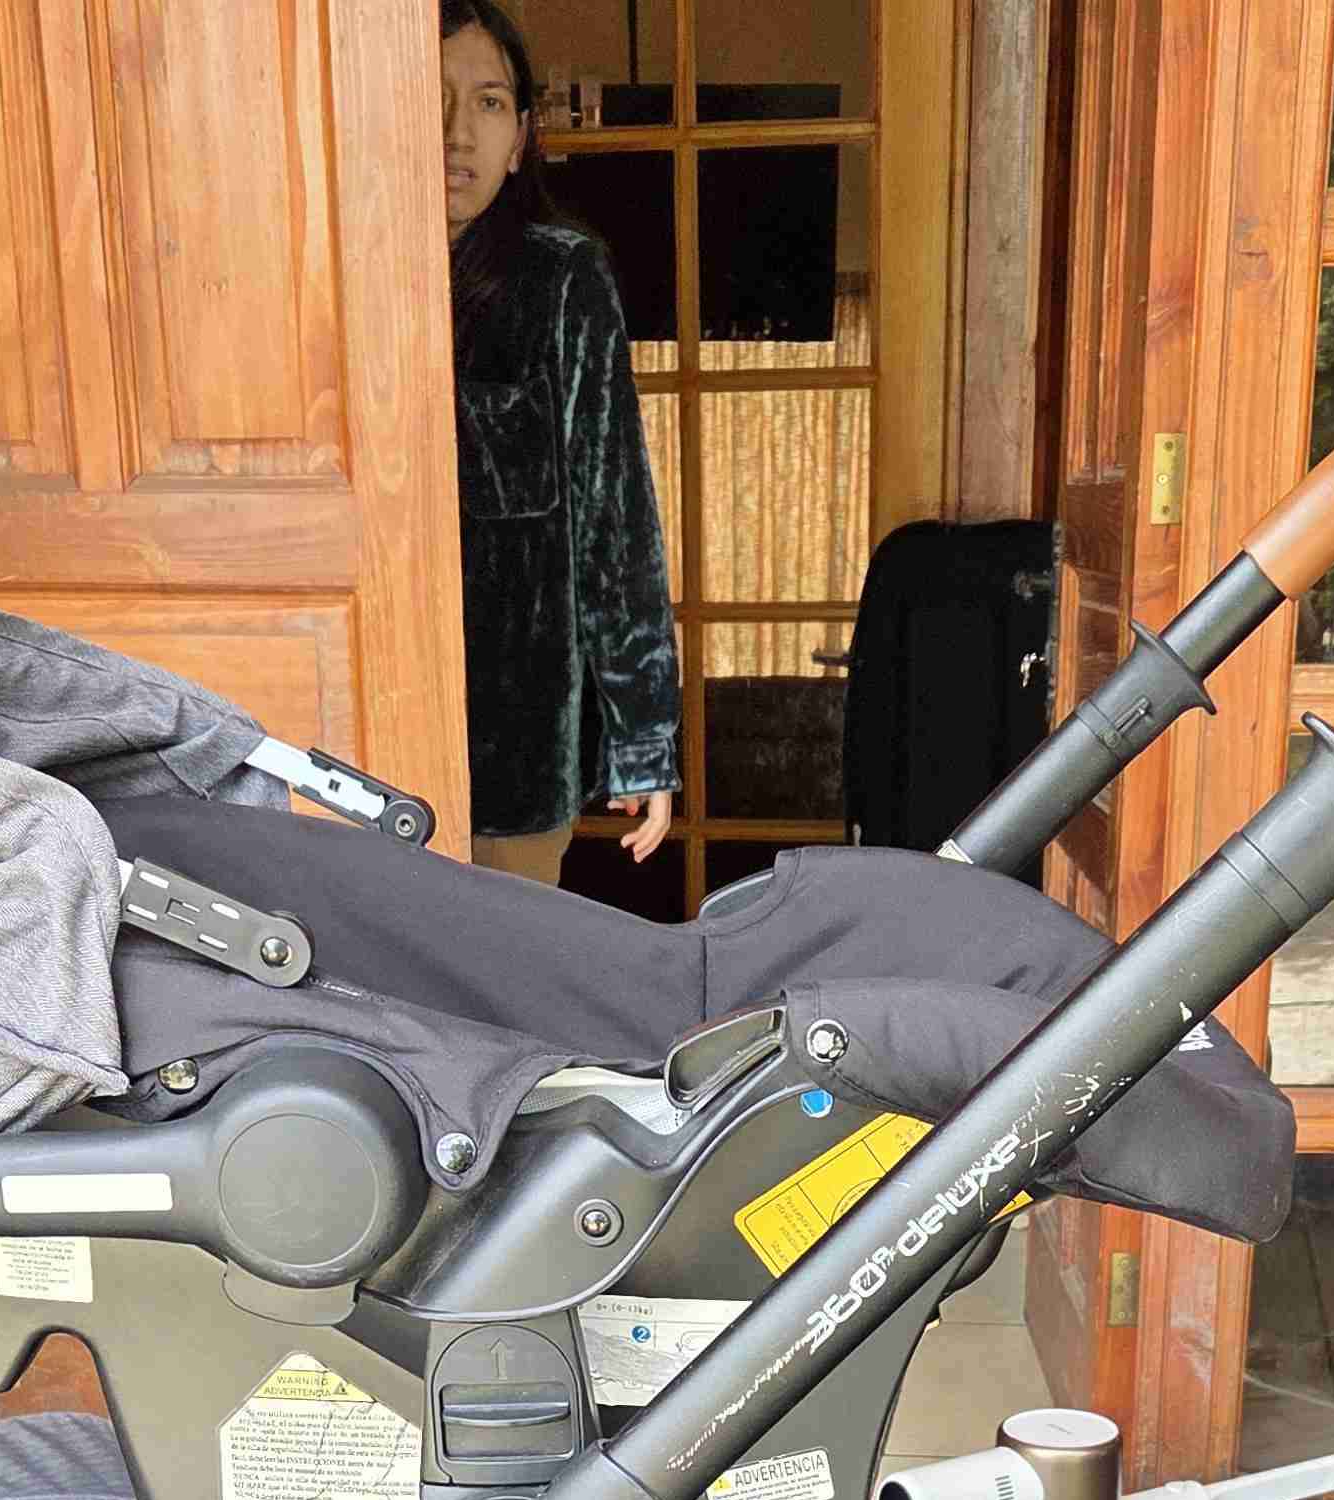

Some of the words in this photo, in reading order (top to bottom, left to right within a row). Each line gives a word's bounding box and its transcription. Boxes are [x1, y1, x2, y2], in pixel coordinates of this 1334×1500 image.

[897, 1133, 1020, 1256] deluxe
[277, 1375, 329, 1386] WARNING
[734, 1454, 826, 1489] ADVERTENCIA
